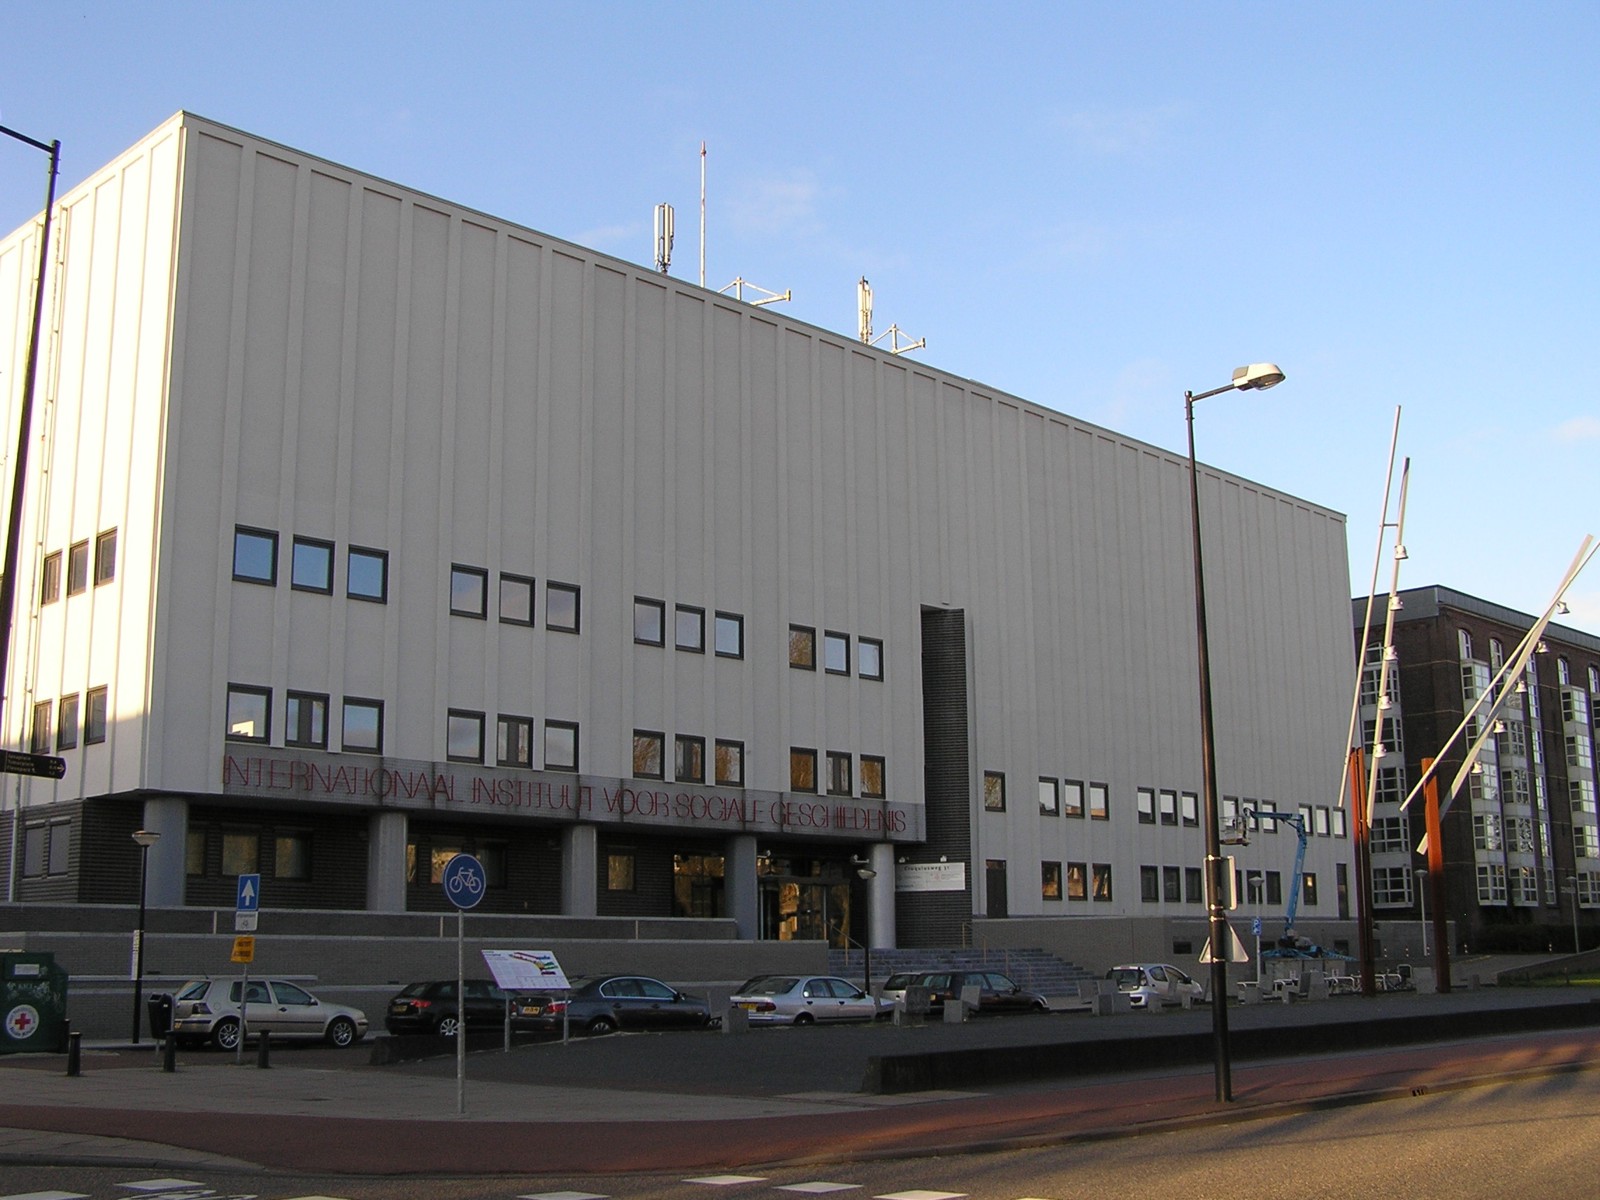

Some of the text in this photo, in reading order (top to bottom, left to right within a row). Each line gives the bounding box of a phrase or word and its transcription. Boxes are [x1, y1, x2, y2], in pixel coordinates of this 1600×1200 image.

[223, 755, 907, 832] INTERNATIONAAL INSTITUUT VOOR SOCIALE GESCHIEDENIS
